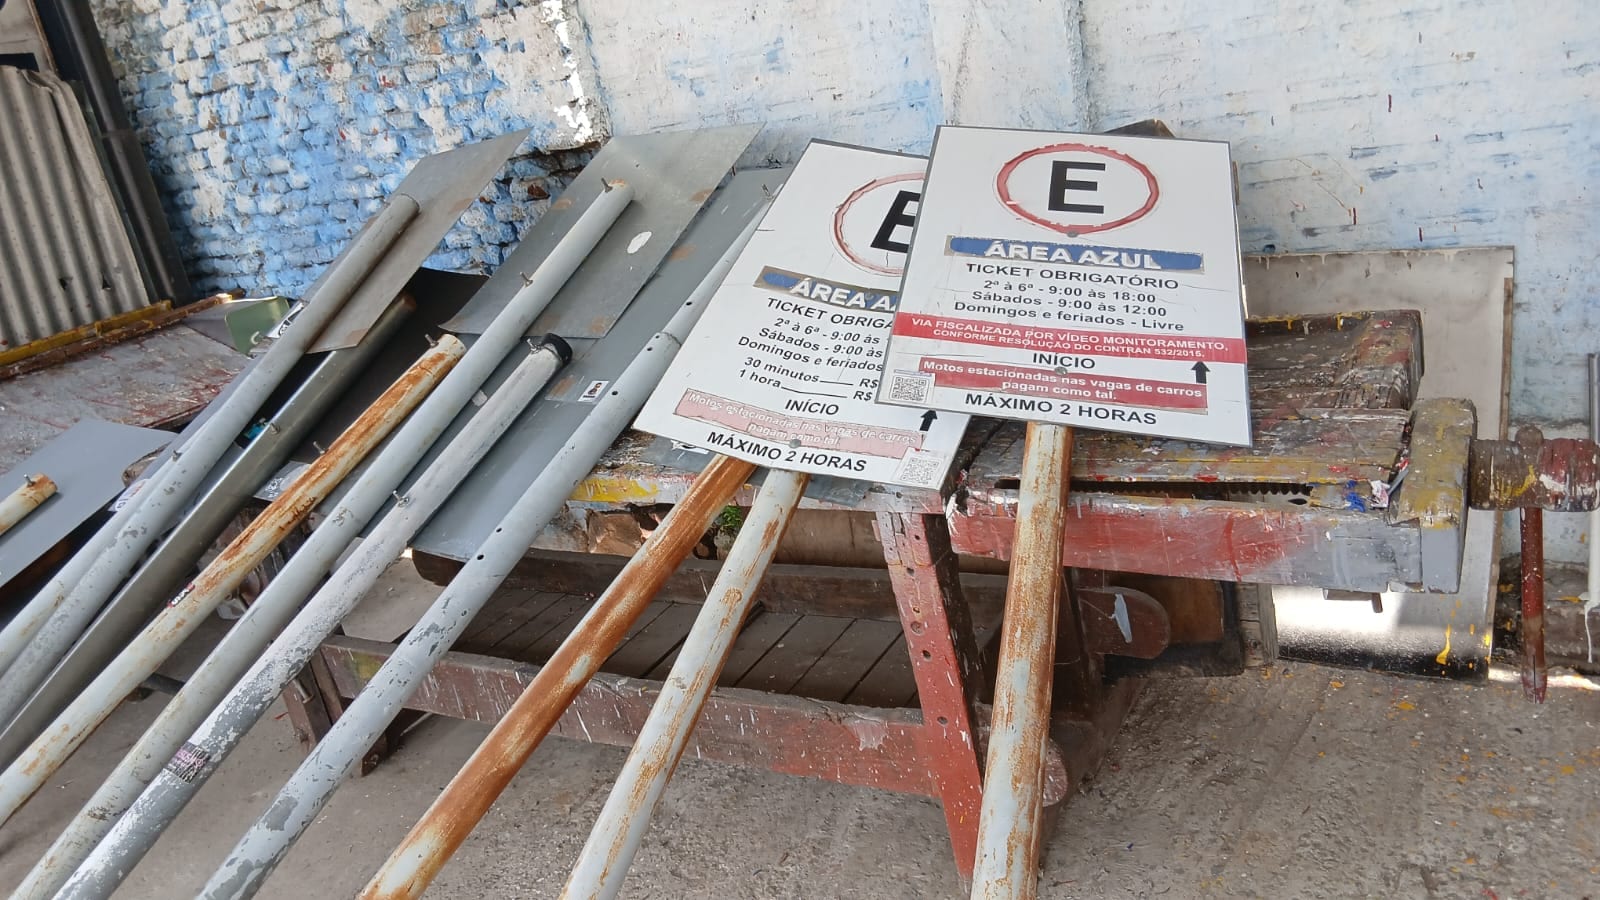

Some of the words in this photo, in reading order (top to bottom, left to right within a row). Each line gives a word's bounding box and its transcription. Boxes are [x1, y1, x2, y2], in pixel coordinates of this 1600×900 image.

[1048, 160, 1106, 214] E
[870, 190, 921, 253] E
[984, 241, 1072, 263] ÁREA
[1078, 249, 1162, 270] AZUL
[966, 263, 1034, 278] TICKET
[1039, 269, 1179, 289] OBRIGATÓRIO
[789, 278, 866, 308] ÁREA
[971, 290, 1042, 306] Sábados
[1057, 299, 1092, 310] 9:00
[1098, 300, 1117, 312] às
[1123, 305, 1167, 317] 12:00
[1048, 285, 1083, 297] 9:00
[1087, 287, 1106, 299] às
[1112, 291, 1156, 303] 18:00
[767, 297, 828, 320] TICKET
[954, 301, 1037, 319] Domingos
[1042, 311, 1052, 319] e
[1057, 311, 1125, 326] feriados
[1142, 319, 1184, 331] Livre
[759, 327, 820, 351] Sábados
[833, 345, 863, 356] 9:00
[866, 347, 884, 358] às
[830, 331, 860, 342] 9:00
[863, 332, 881, 344] às
[911, 317, 932, 327] VIA
[935, 320, 1021, 337] FISCALIZADA
[1025, 330, 1056, 340] POR
[1058, 332, 1100, 343] VÍDEO
[933, 329, 996, 342] CONFORME
[999, 336, 1071, 349] RESOLUÇÃO
[1074, 343, 1092, 351] DO
[1094, 345, 1151, 354] CONTRAN
[737, 336, 810, 363] Domingos
[814, 356, 823, 365] e
[826, 356, 884, 372] feriados
[1033, 352, 1096, 369] INÍCIO
[740, 369, 746, 378] 1
[749, 371, 782, 388] hora
[853, 390, 873, 402] R$
[744, 356, 761, 368] 30
[764, 363, 820, 383] minutos
[859, 377, 880, 389] R$
[923, 360, 964, 373] Motos
[967, 366, 1057, 383] estacionadas
[1061, 376, 1086, 386] nas
[1090, 379, 1132, 391] vagas
[1136, 383, 1153, 392] de
[1157, 387, 1202, 397] carros
[1002, 381, 1049, 393] pagam
[1052, 386, 1092, 397] como
[1095, 390, 1117, 400] tal.
[689, 393, 722, 411] Motos
[726, 404, 799, 429] estacionadas
[802, 421, 821, 431] nas
[825, 425, 858, 438] vagas
[860, 429, 877, 439] de
[878, 432, 916, 444] carros
[784, 398, 839, 415] INÍCIO
[964, 393, 1053, 412] MÁXIMO
[1060, 403, 1071, 415] 2
[1078, 405, 1157, 424] HORAS
[747, 422, 788, 439] pagam
[790, 433, 823, 444] como
[707, 431, 782, 460] MÁXIMO
[785, 451, 797, 462] 2
[800, 452, 867, 471] HORAS
